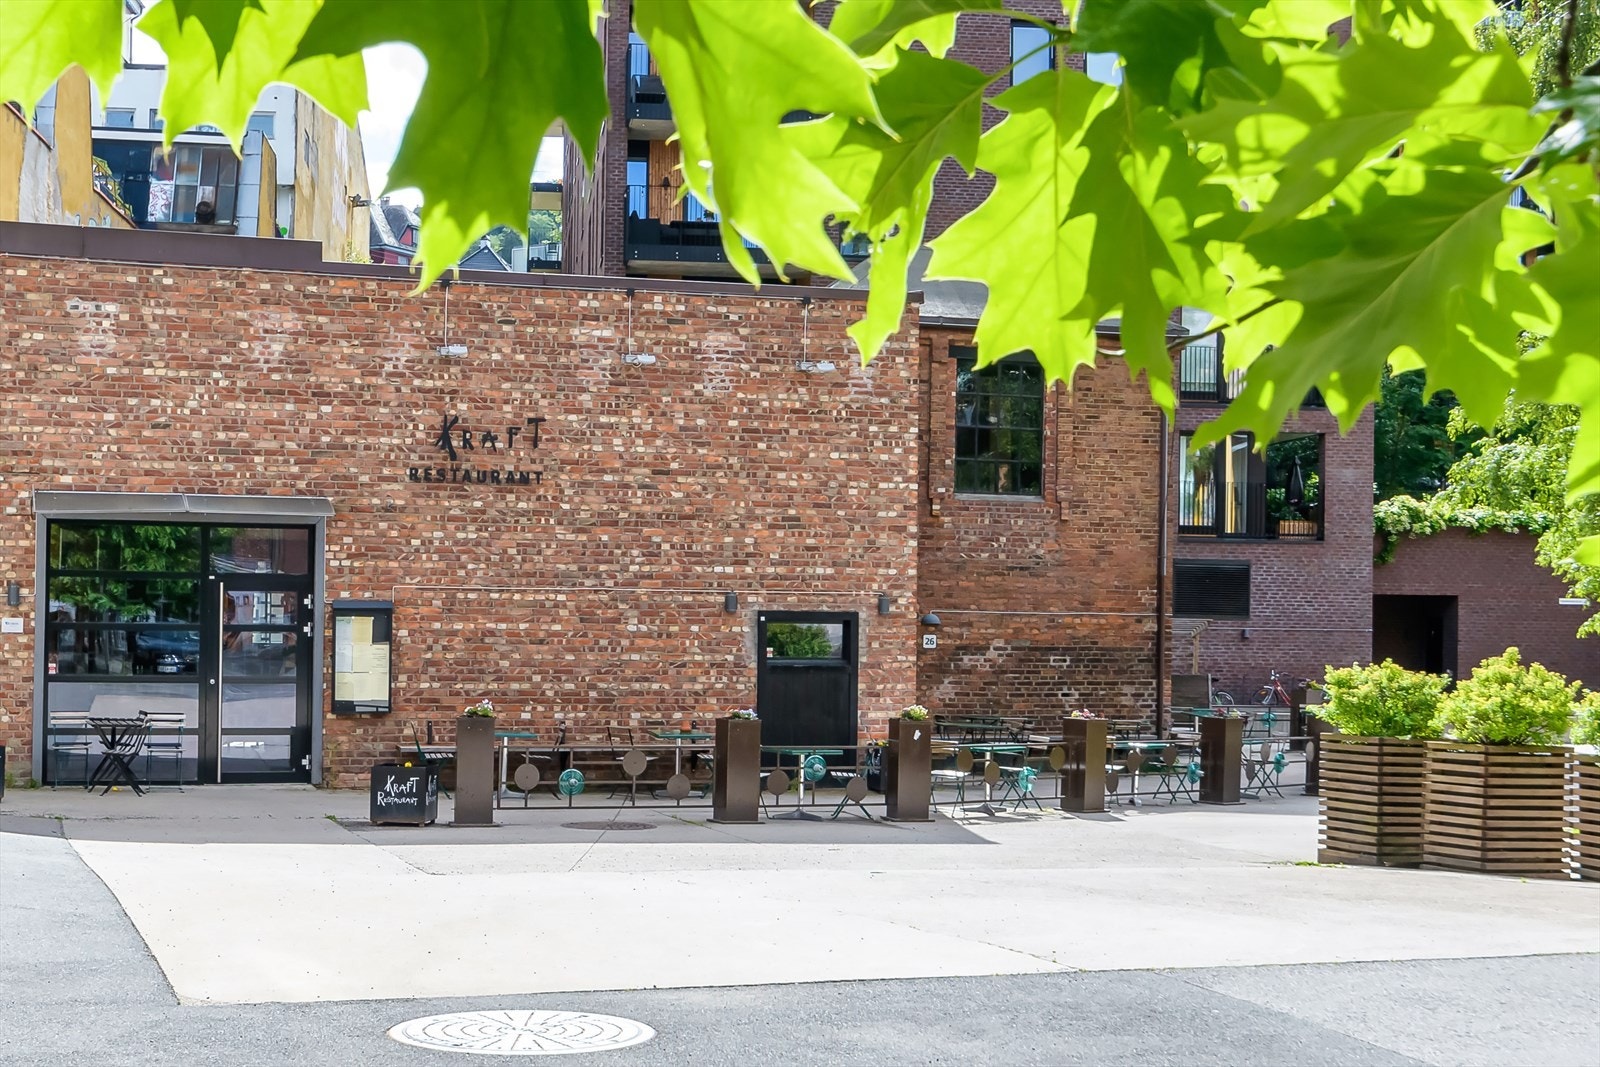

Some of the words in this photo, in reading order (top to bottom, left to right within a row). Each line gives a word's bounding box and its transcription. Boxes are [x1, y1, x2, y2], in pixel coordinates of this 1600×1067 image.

[434, 413, 546, 461] KRAFT
[409, 467, 543, 485] RESTAURANT
[925, 637, 935, 646] 26
[384, 775, 420, 796] KRAFT
[377, 791, 418, 806] RESTAURANT
